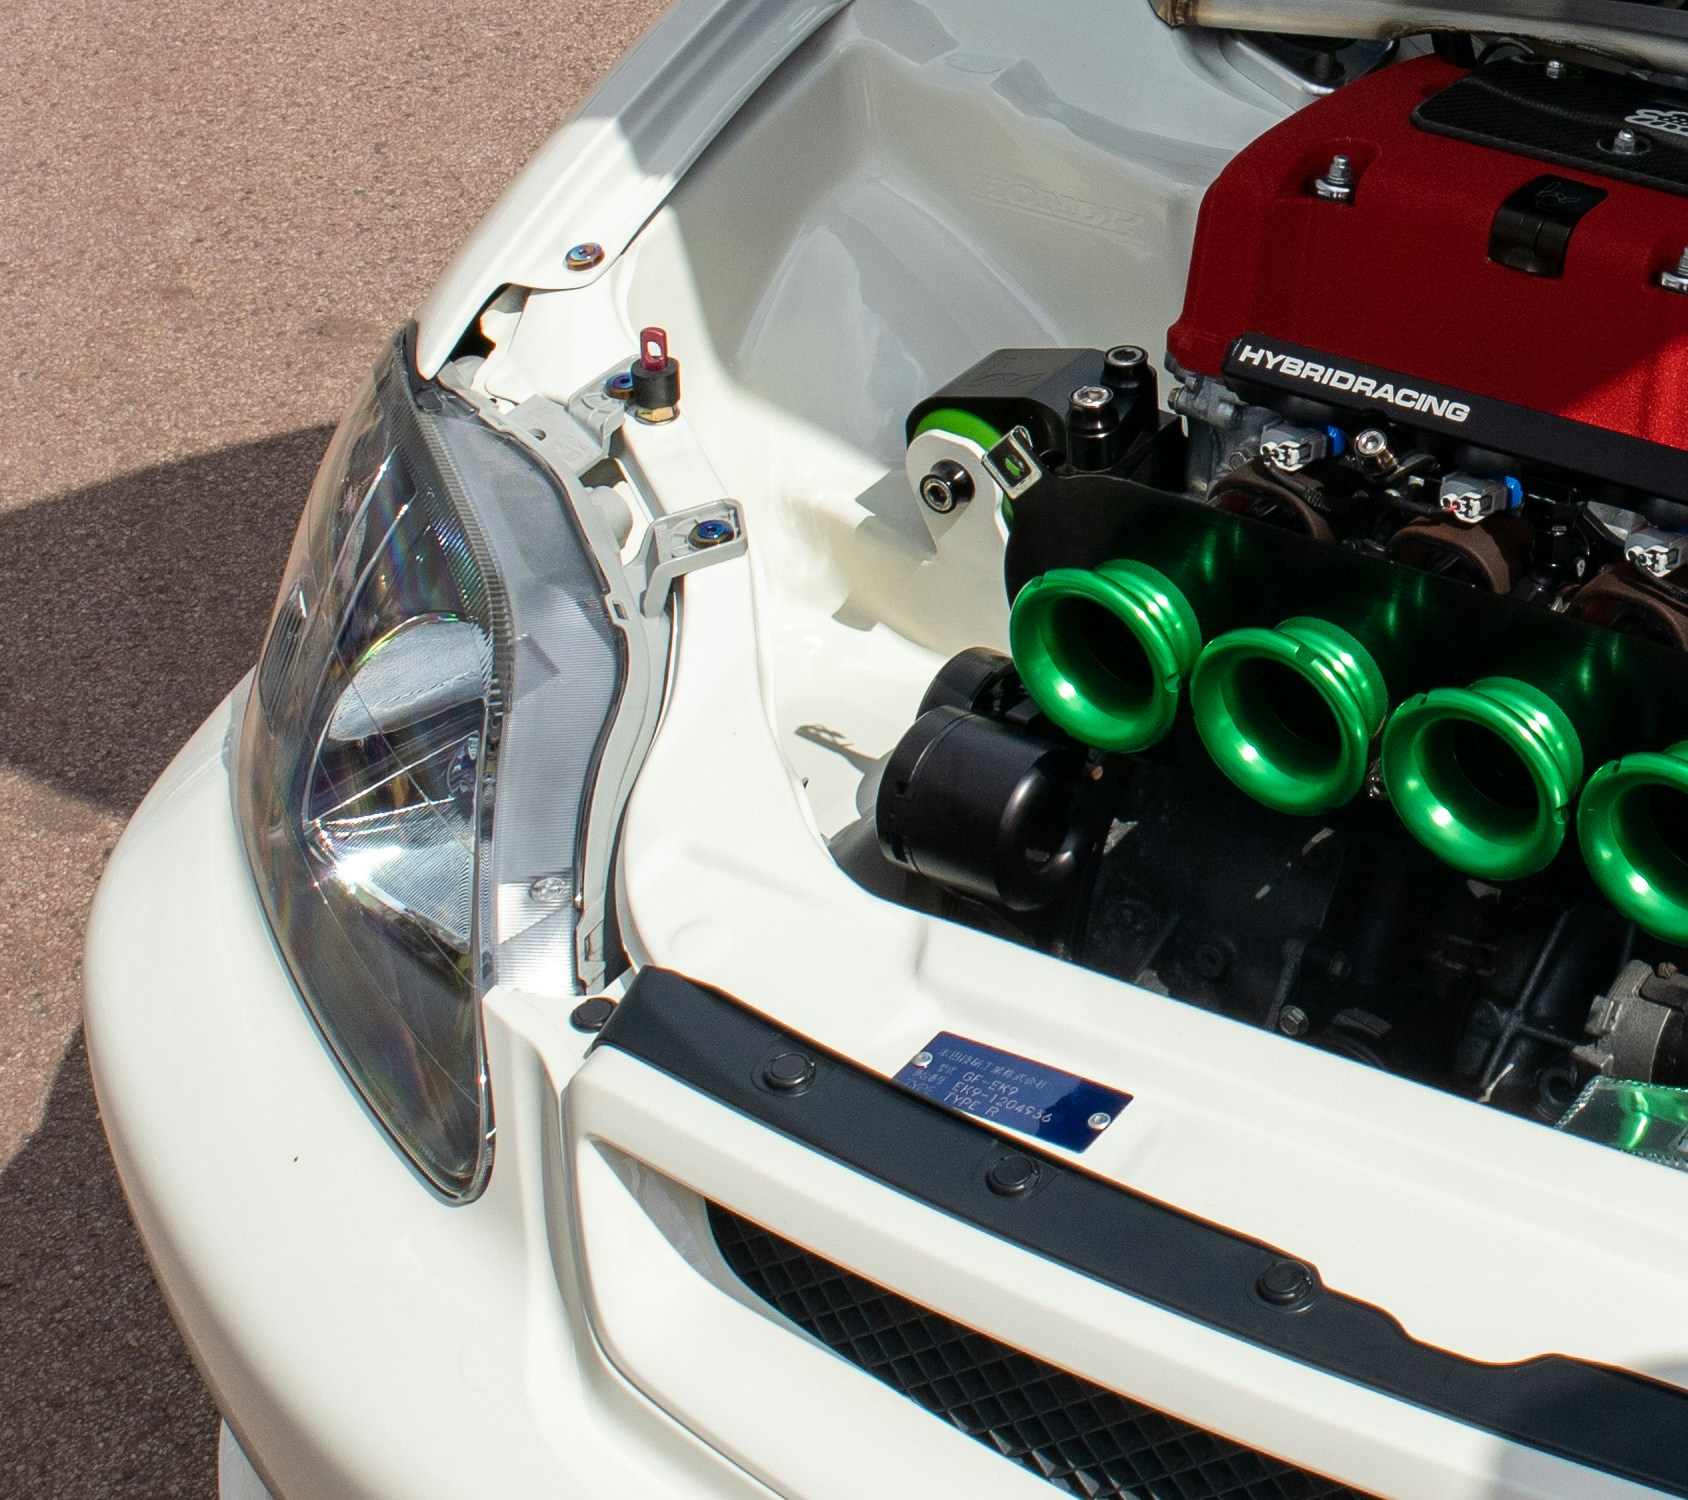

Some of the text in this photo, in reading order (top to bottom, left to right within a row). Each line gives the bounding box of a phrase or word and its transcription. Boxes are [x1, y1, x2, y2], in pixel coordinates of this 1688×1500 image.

[1238, 344, 1471, 423] HYBRIDRACING
[962, 1071, 1020, 1096] GF-EK9
[944, 1092, 983, 1112] TYPE
[984, 1104, 1001, 1118] R
[950, 1081, 1054, 1124] EK9-1204936
